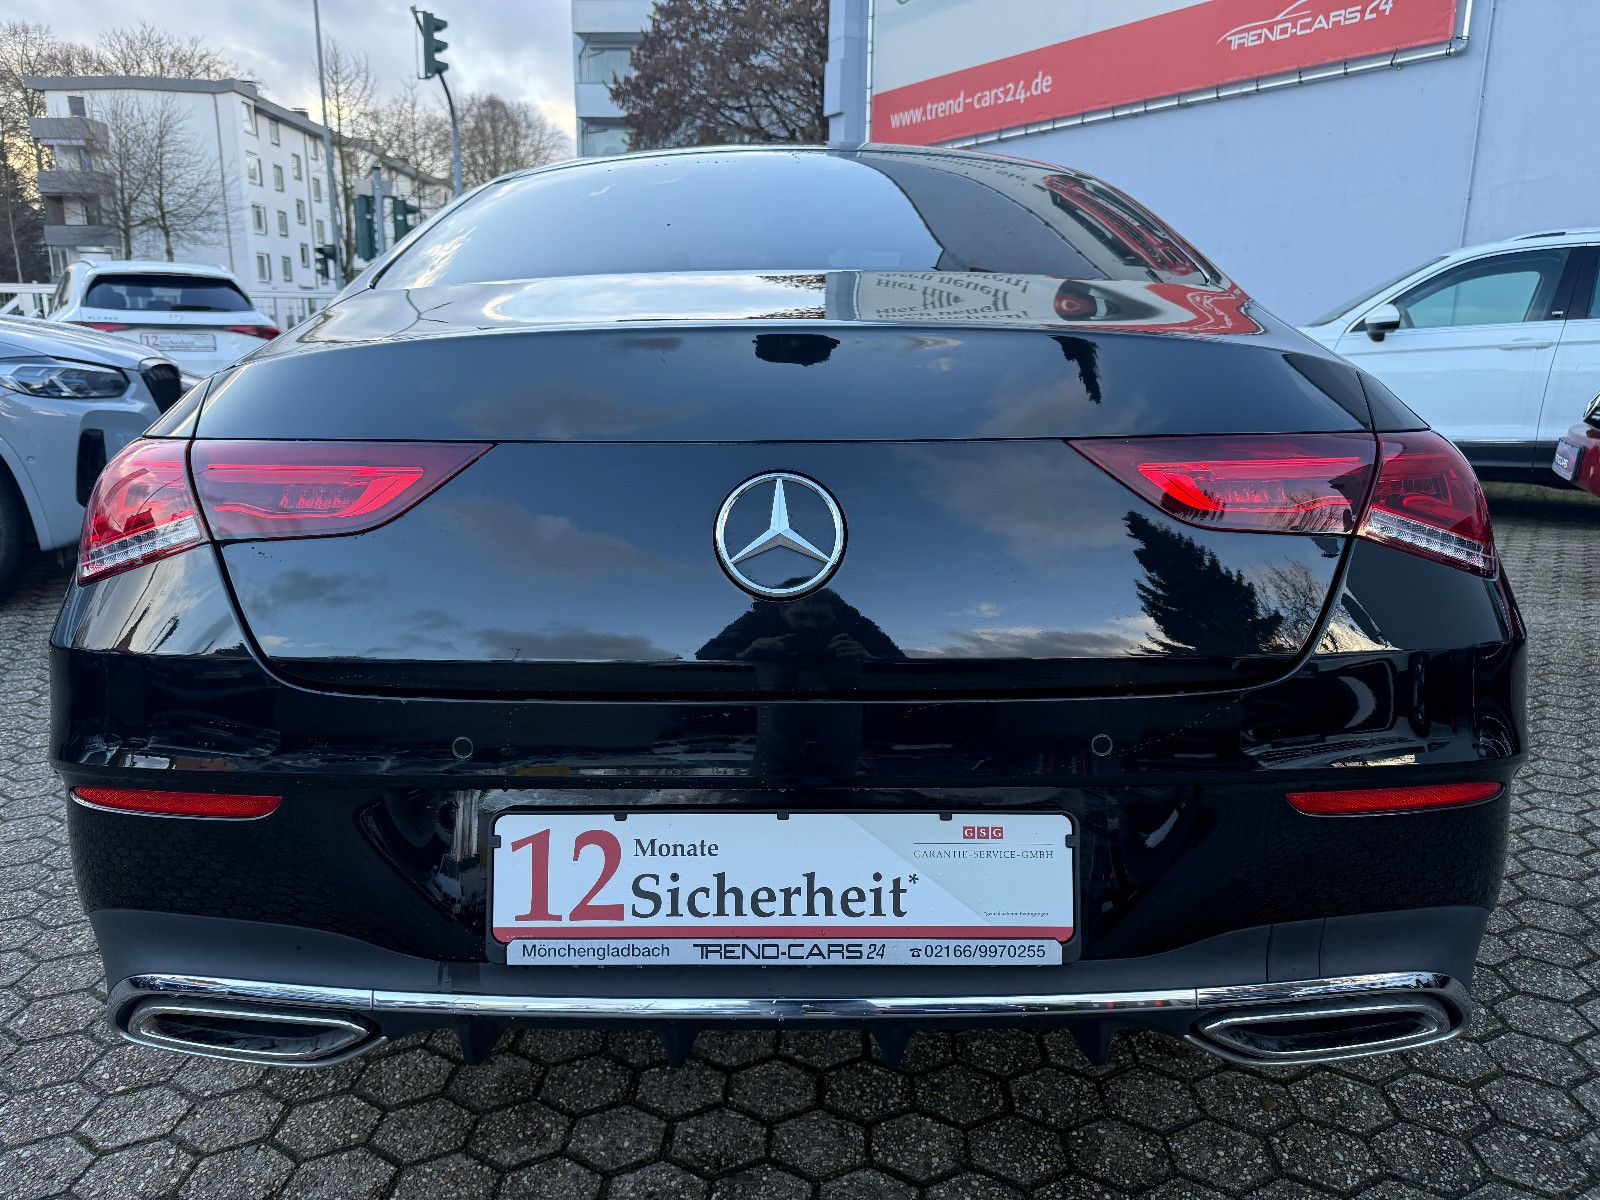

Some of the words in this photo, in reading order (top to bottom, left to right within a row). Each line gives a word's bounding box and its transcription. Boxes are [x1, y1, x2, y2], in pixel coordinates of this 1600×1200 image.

[1227, 6, 1362, 51] TREND-CARS
[890, 70, 1053, 129] www.trend-cars24.de
[963, 826, 1003, 839] GSG
[633, 838, 719, 857] Monate
[913, 849, 1054, 859] GARANTIE-SERVICE-GMBH
[511, 828, 625, 922] 12
[521, 943, 671, 961] Mönchengladbach
[692, 943, 863, 960] TREND-CARS
[866, 943, 886, 960] 24
[924, 944, 1046, 959] 02166/9970255
